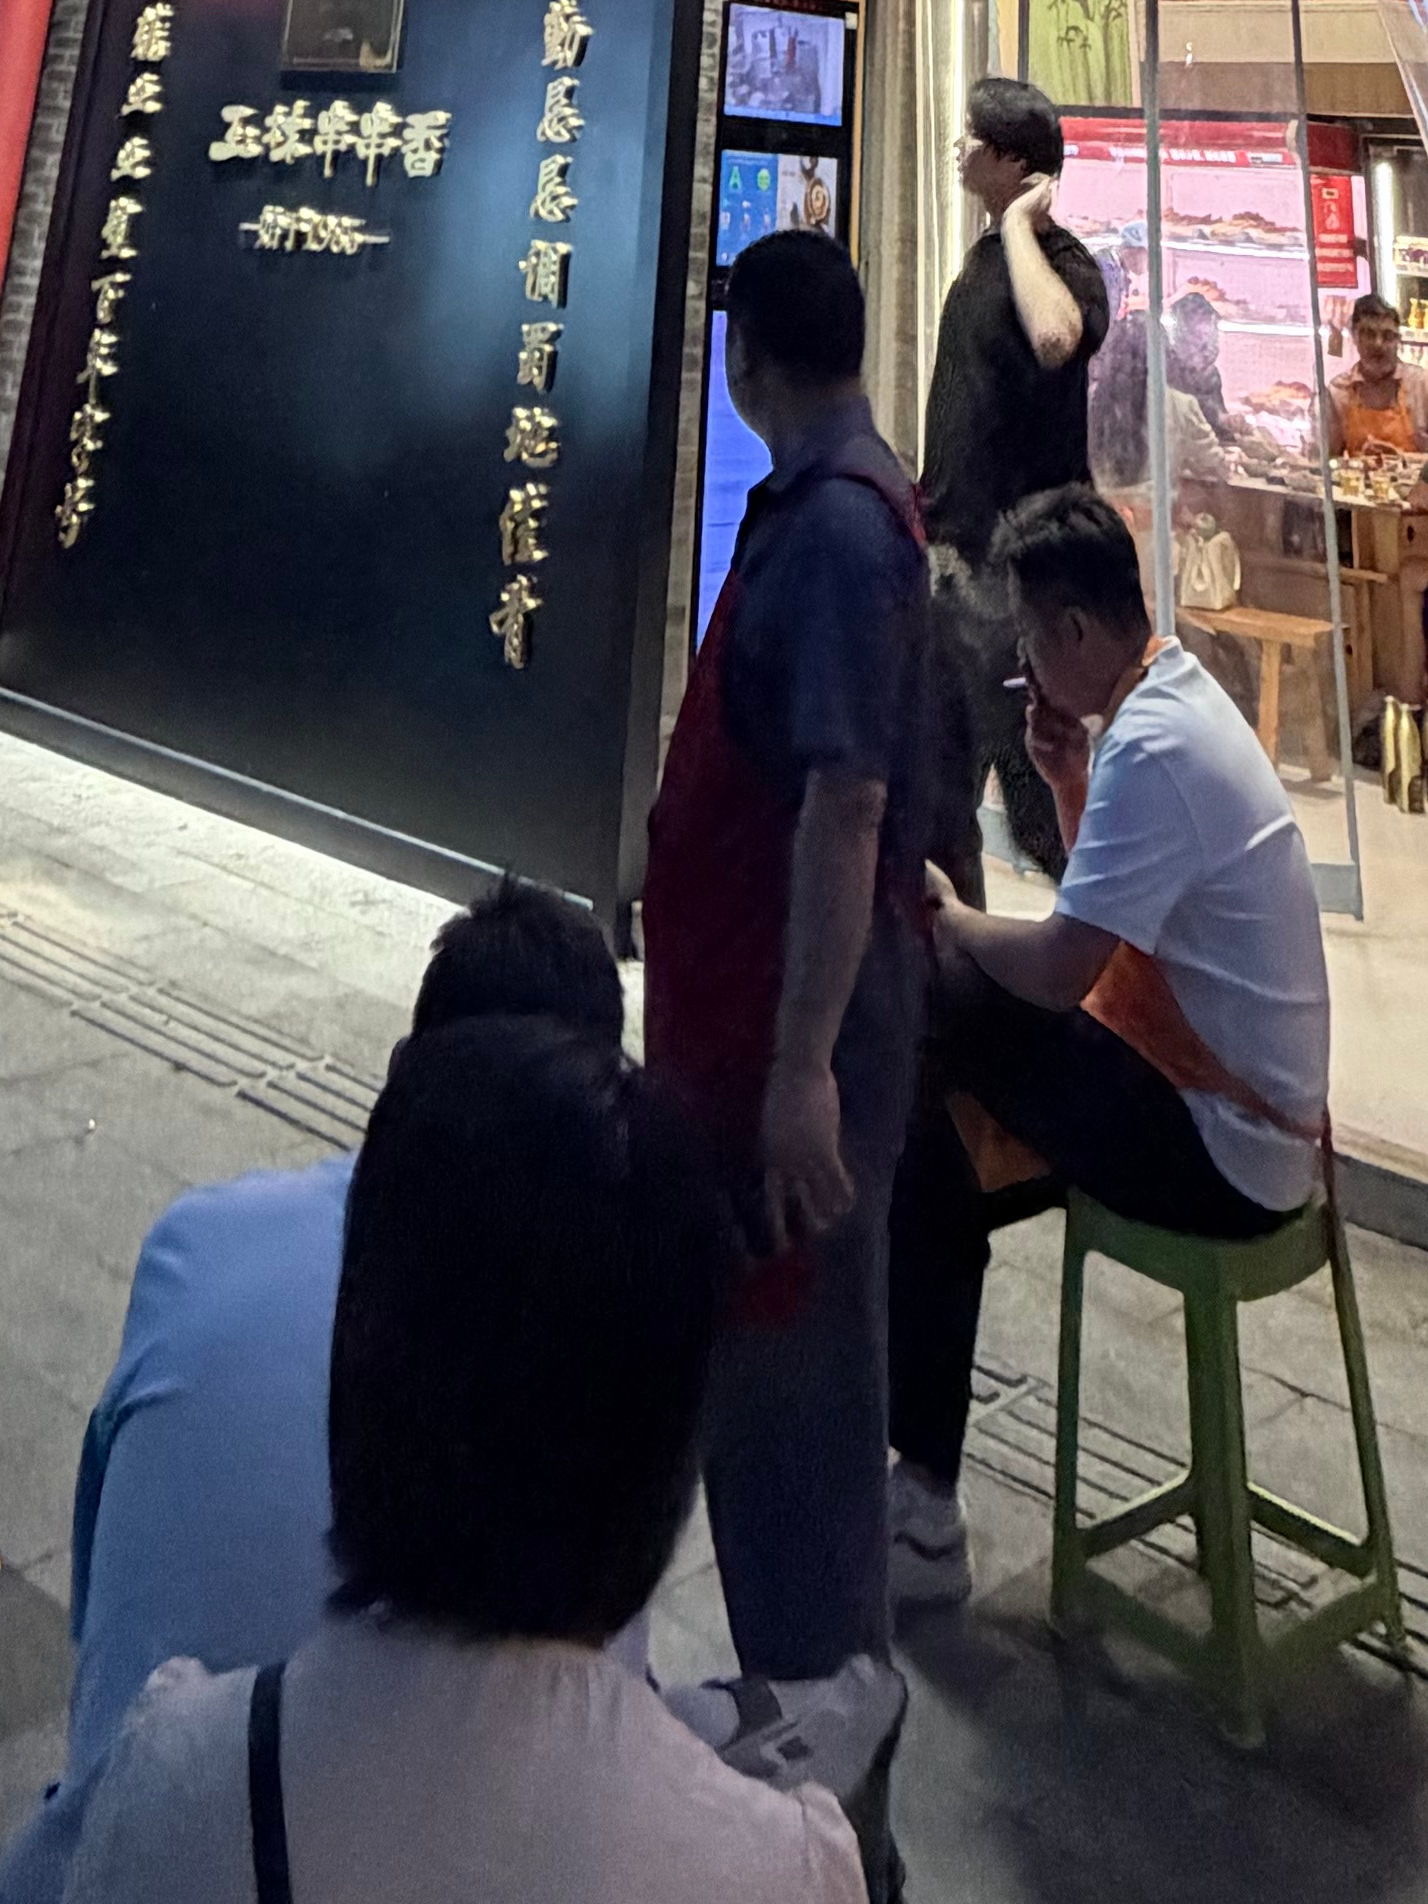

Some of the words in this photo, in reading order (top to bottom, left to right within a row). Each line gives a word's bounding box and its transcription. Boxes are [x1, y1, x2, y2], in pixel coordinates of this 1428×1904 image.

[208, 99, 451, 187] 玉林串串香
